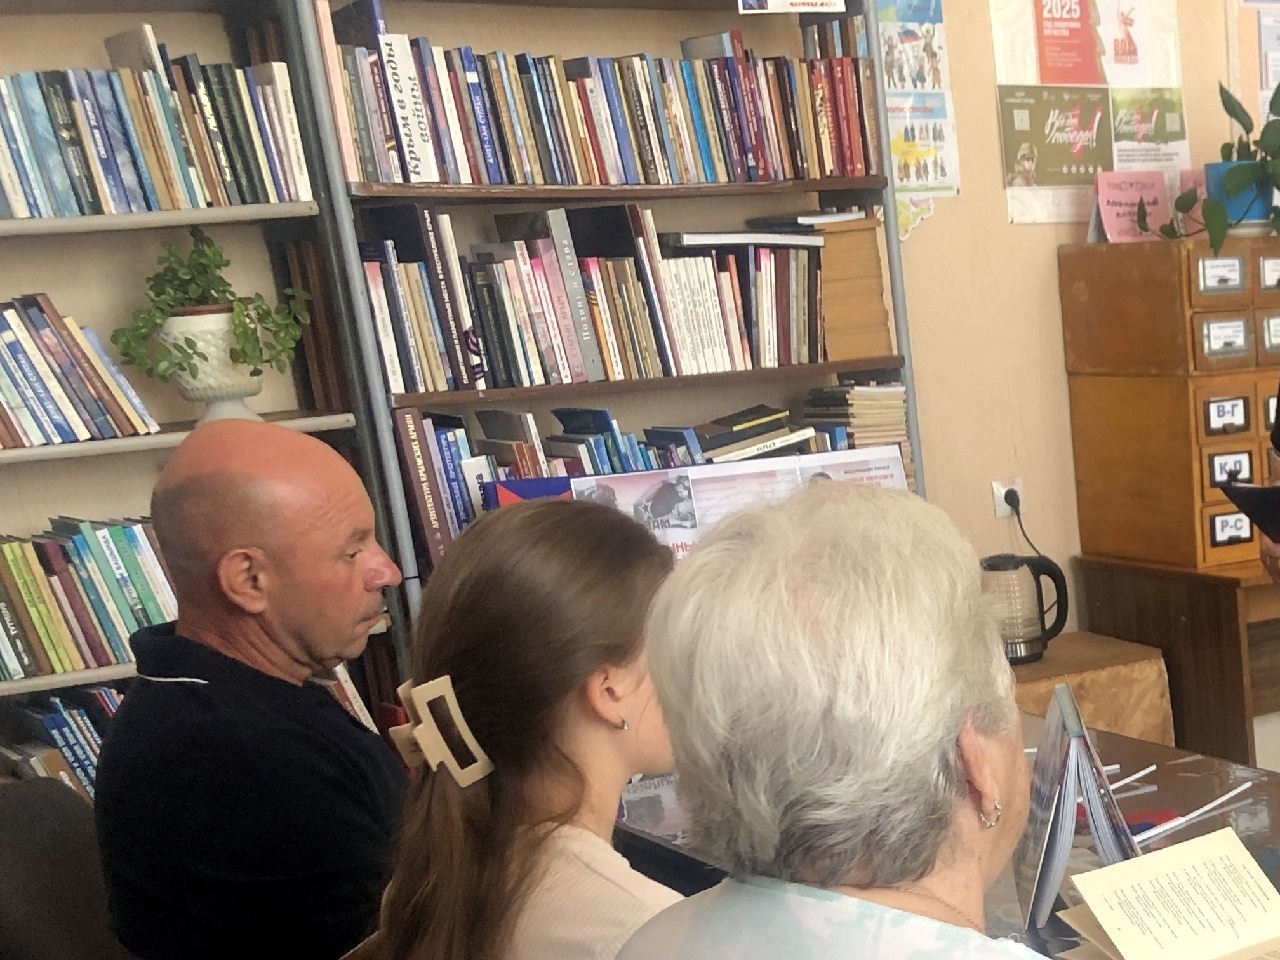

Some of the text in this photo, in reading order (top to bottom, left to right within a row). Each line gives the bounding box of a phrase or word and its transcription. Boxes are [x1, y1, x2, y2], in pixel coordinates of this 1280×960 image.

[1042, 0, 1081, 18] 2025
[385, 42, 404, 93] годы
[408, 77, 430, 143] войны
[400, 116, 421, 176] Крым
[1216, 404, 1239, 418] В-Г
[1220, 518, 1243, 532] Р-С
